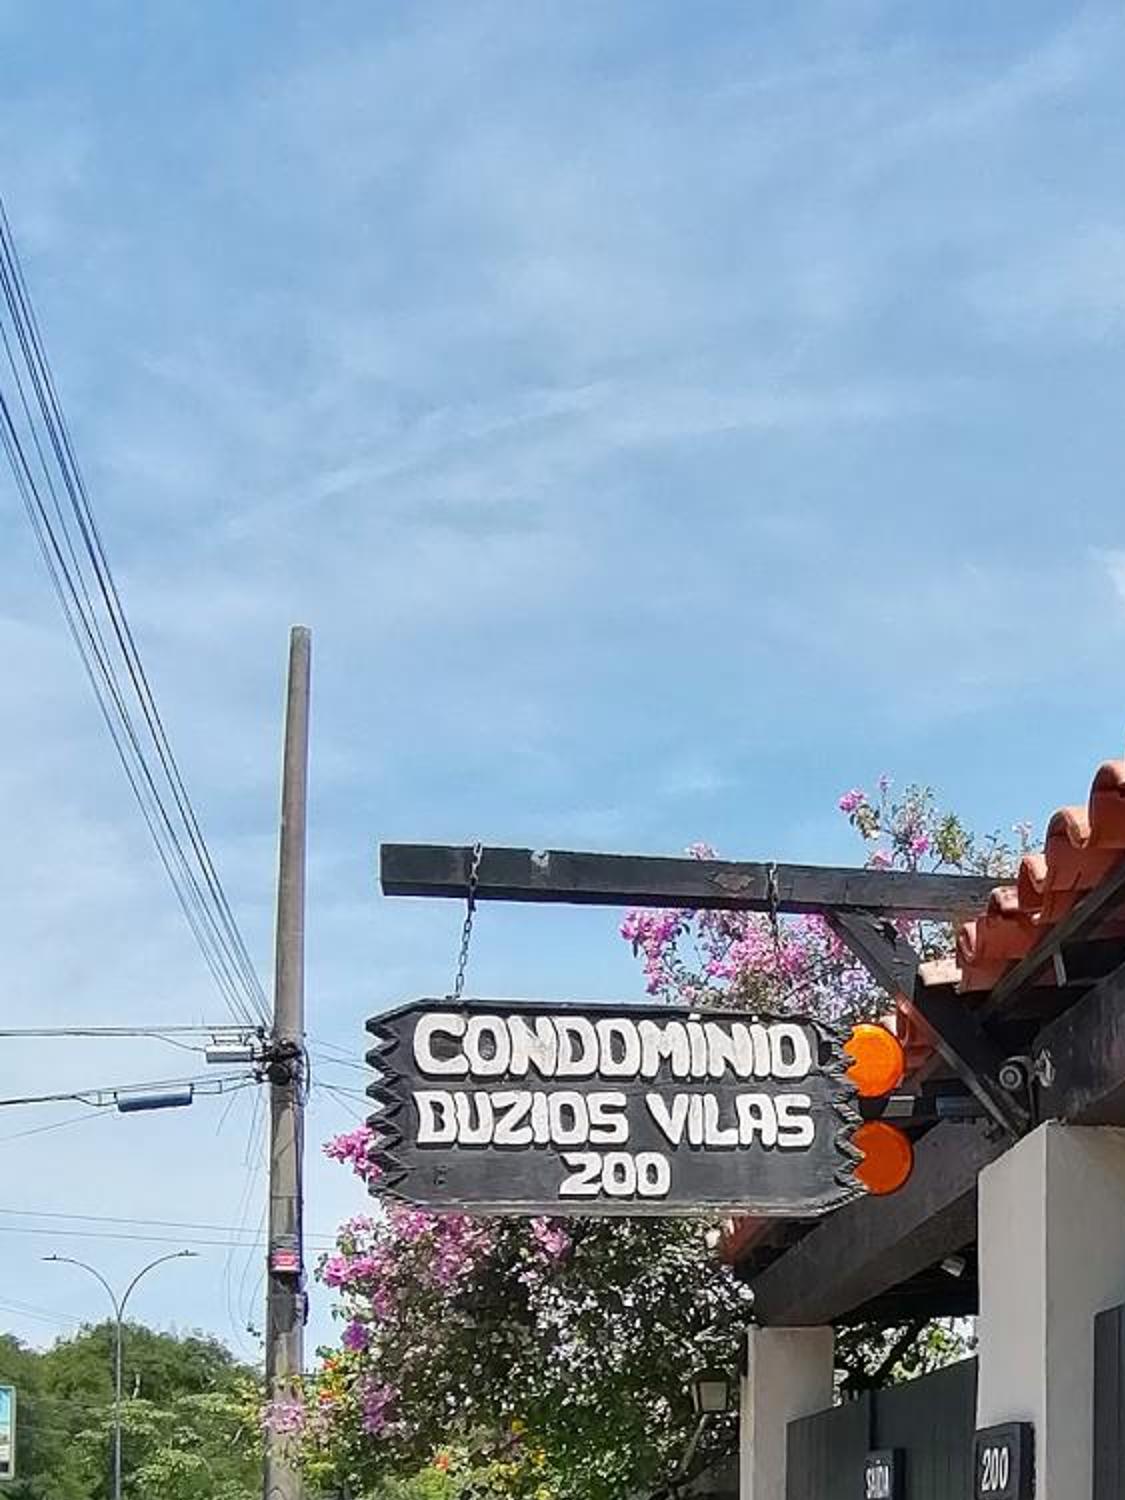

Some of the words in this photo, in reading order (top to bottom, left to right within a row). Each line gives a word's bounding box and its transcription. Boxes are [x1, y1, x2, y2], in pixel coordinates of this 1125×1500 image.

[411, 1089, 630, 1146] BUZIOS
[645, 1092, 816, 1148] VILAS
[559, 1151, 672, 1196] 200
[981, 1446, 1010, 1492] 200
